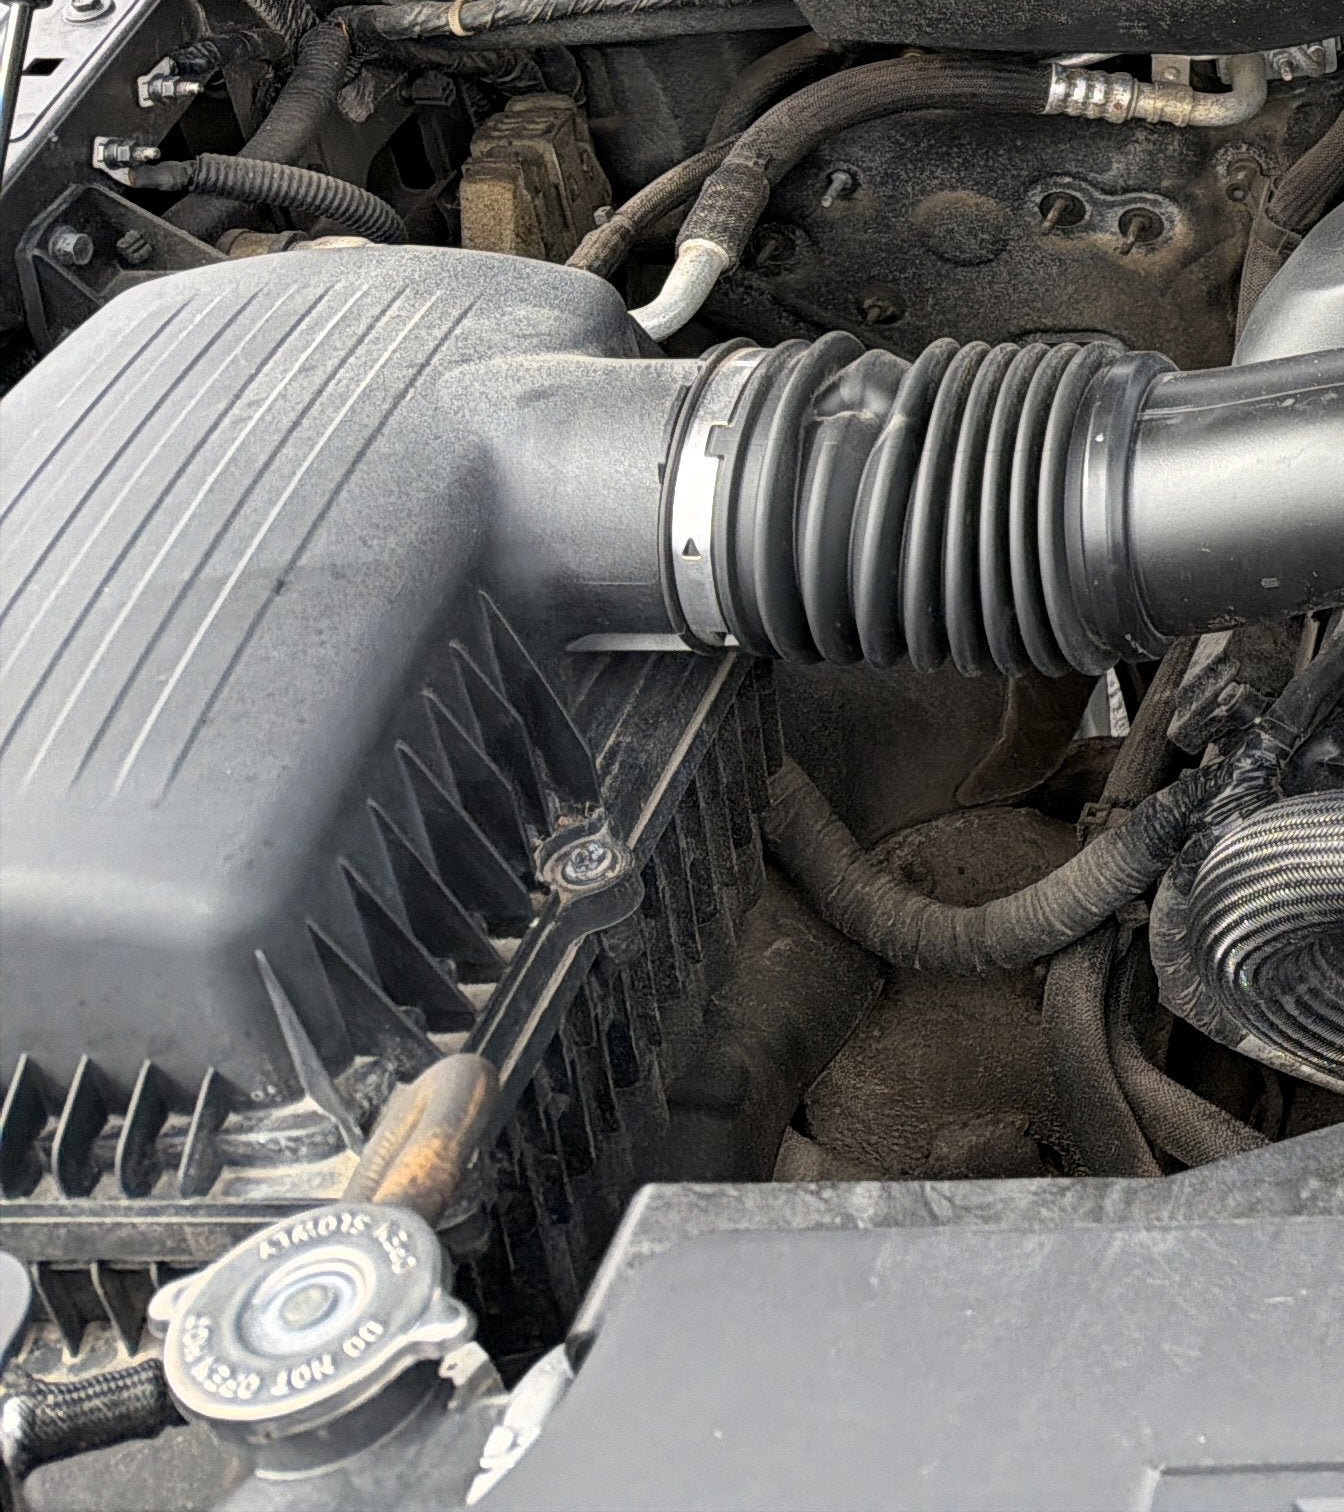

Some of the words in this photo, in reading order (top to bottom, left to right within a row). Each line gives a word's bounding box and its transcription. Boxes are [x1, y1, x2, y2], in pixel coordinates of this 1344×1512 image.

[258, 1212, 372, 1260] SLOWLY
[342, 1319, 384, 1359] DO
[269, 1353, 335, 1397] NOT
